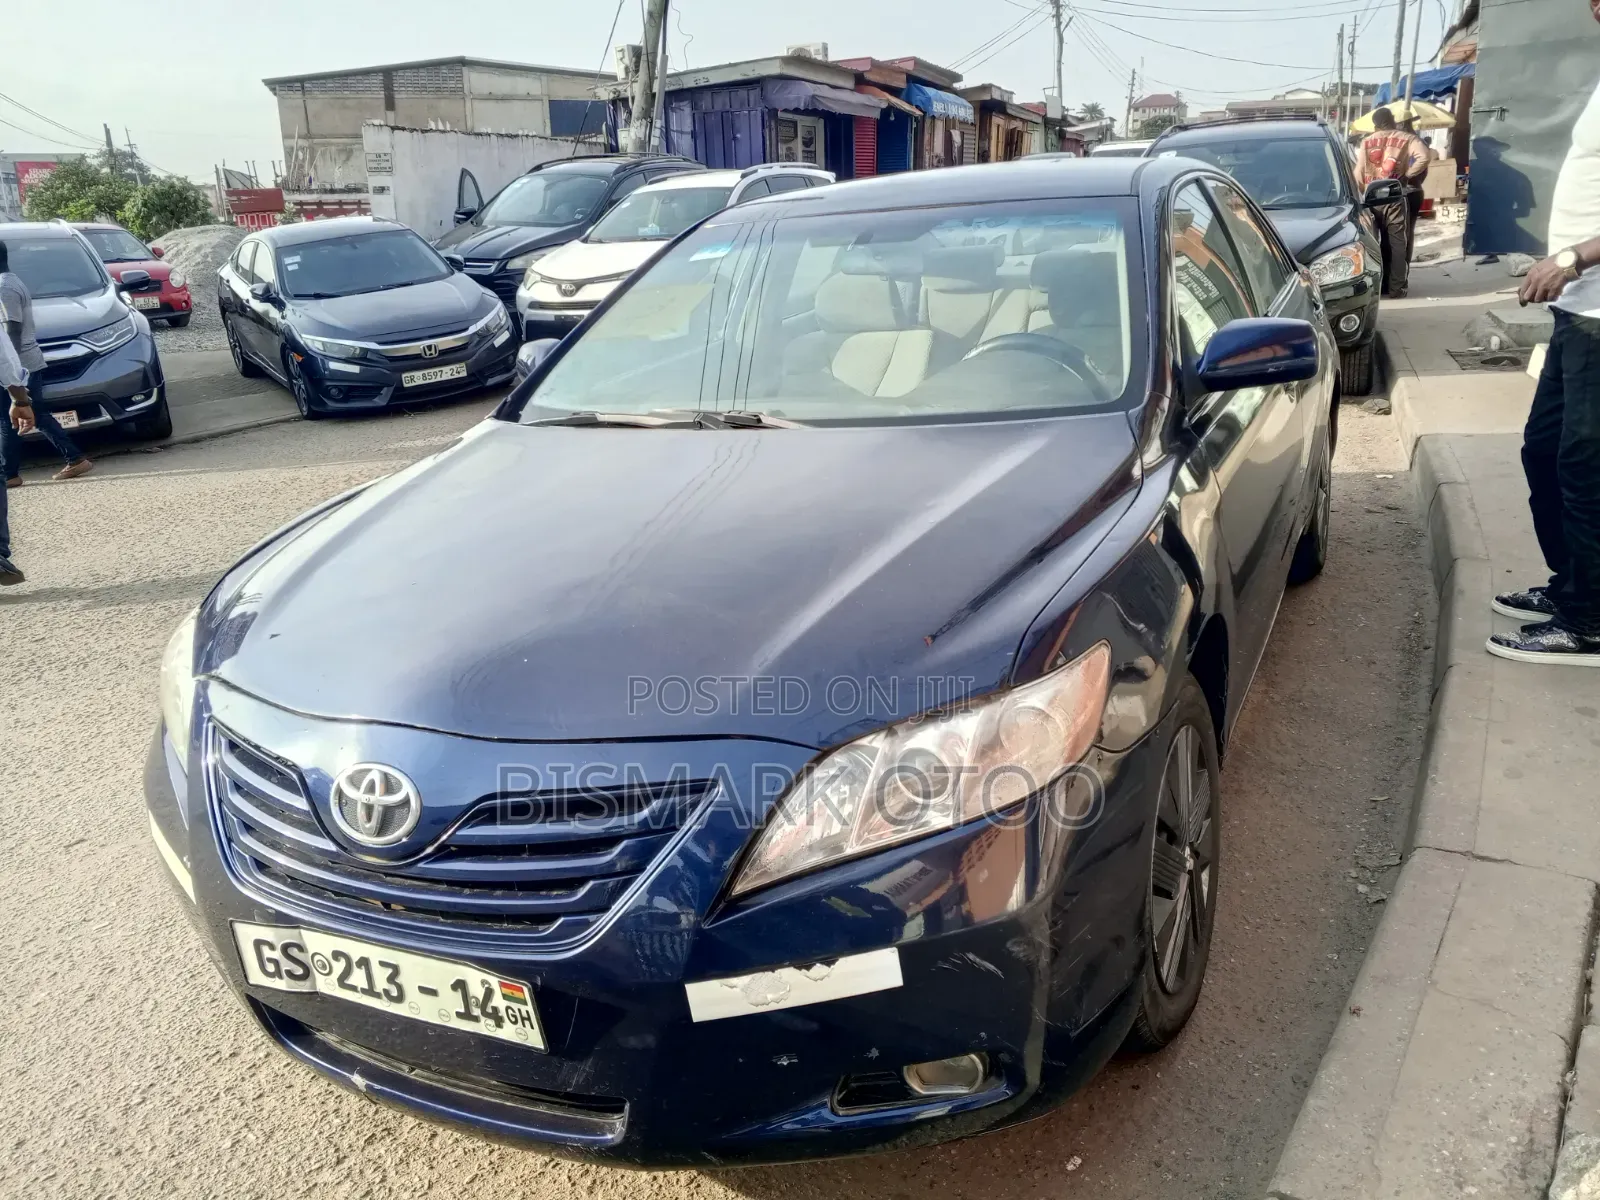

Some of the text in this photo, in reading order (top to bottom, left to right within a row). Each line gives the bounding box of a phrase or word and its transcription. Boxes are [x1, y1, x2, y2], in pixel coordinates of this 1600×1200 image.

[403, 374, 416, 385] GR
[252, 938, 312, 982] GS
[505, 1004, 535, 1031] GH
